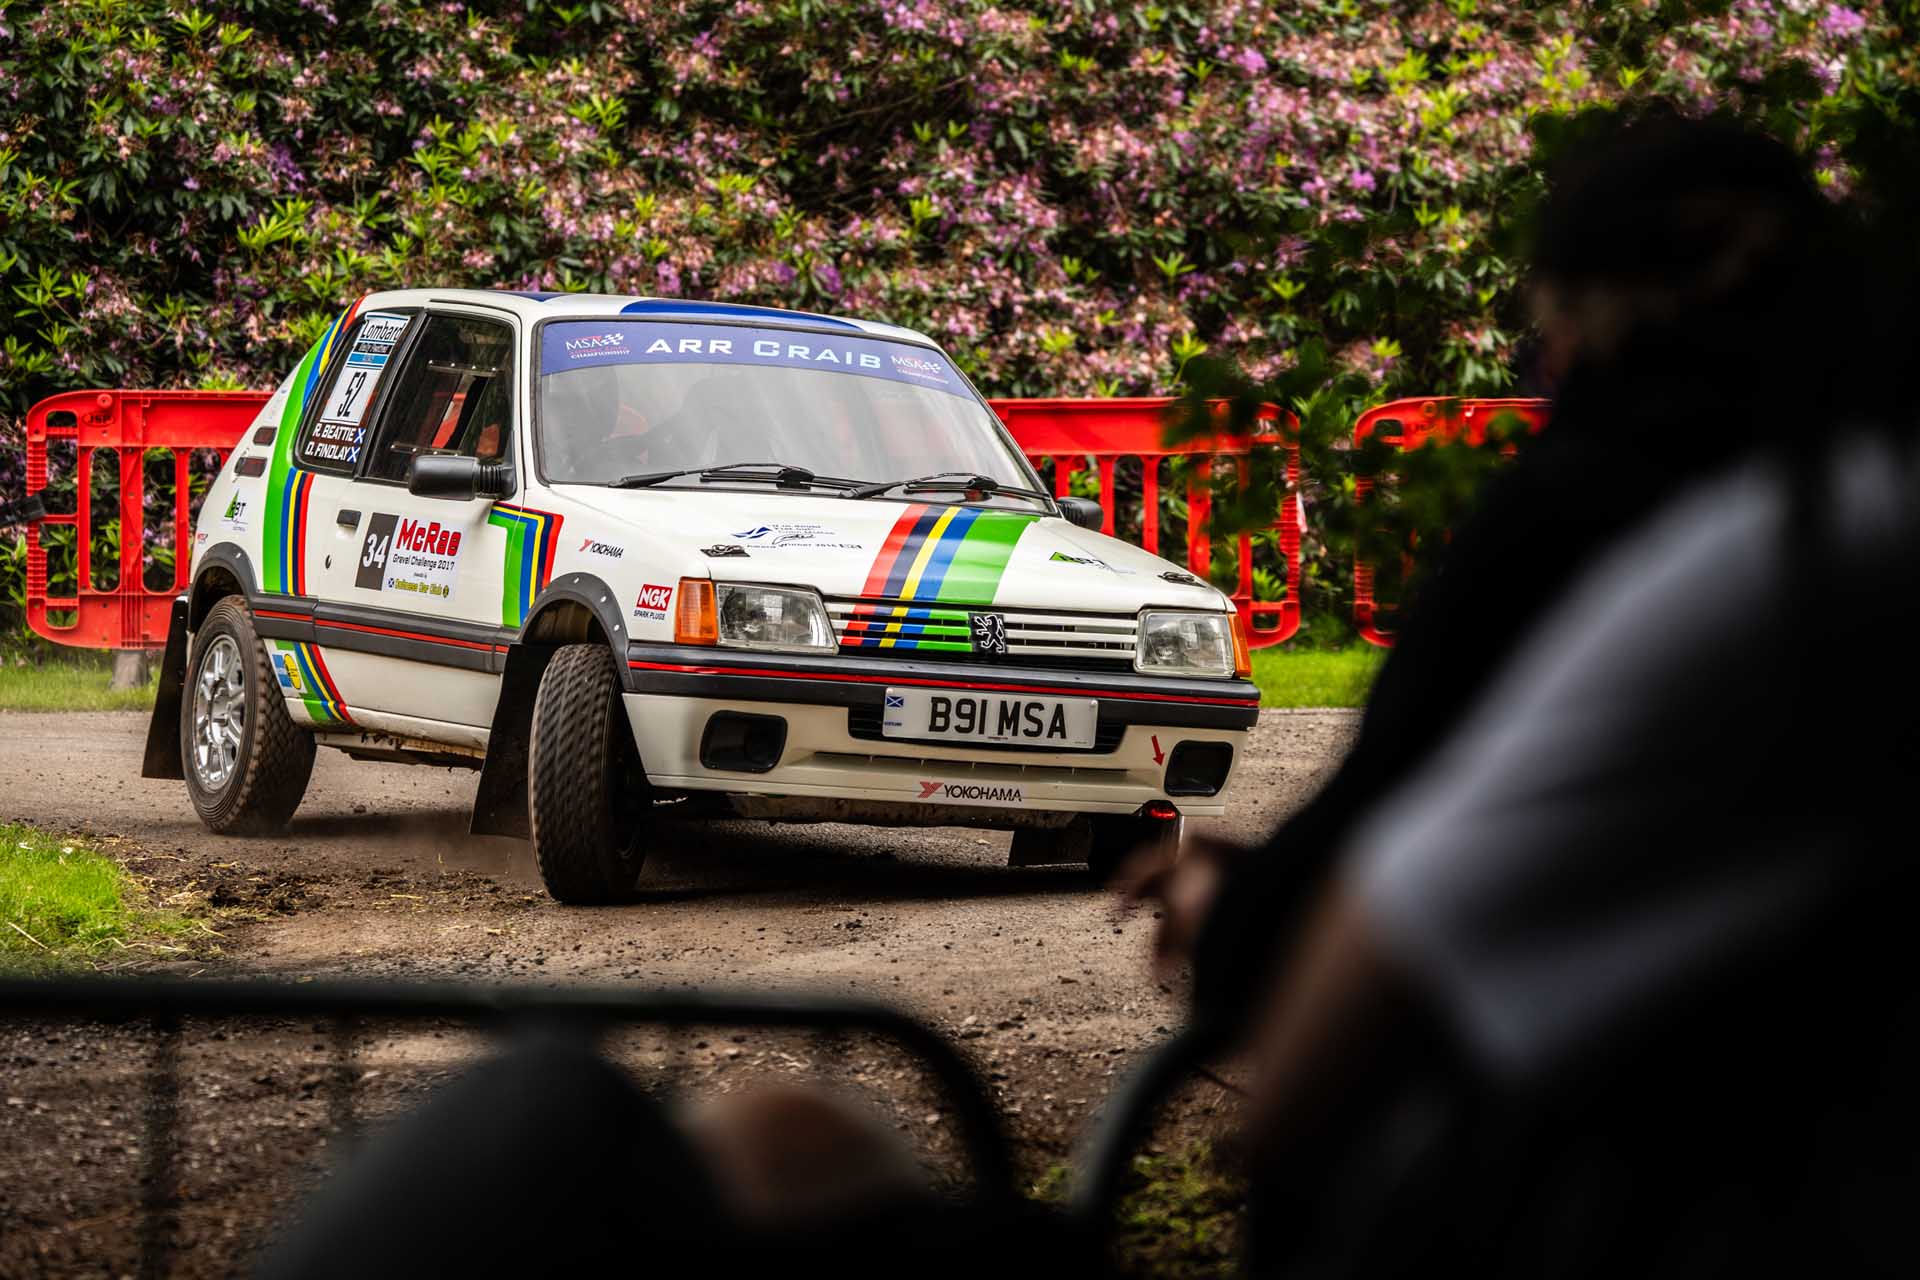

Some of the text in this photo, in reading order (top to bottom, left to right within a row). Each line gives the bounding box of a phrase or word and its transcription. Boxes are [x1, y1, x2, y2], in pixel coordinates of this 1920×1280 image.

[361, 319, 404, 342] Lombard
[565, 338, 602, 350] MSA
[645, 339, 881, 369] ARR CRAIB
[337, 371, 367, 417] 52
[313, 423, 355, 441] R. BEATTIE
[315, 445, 350, 461] FINDLAY
[362, 533, 389, 569] 34
[590, 542, 624, 558] YOKOHAMA
[392, 553, 454, 571] Gravel Challenge 2017
[638, 588, 670, 608] NGK
[633, 609, 665, 621] SPARK PLUGS
[928, 696, 1066, 739] B91 MSA
[944, 784, 1022, 801] YOKOHAMA
